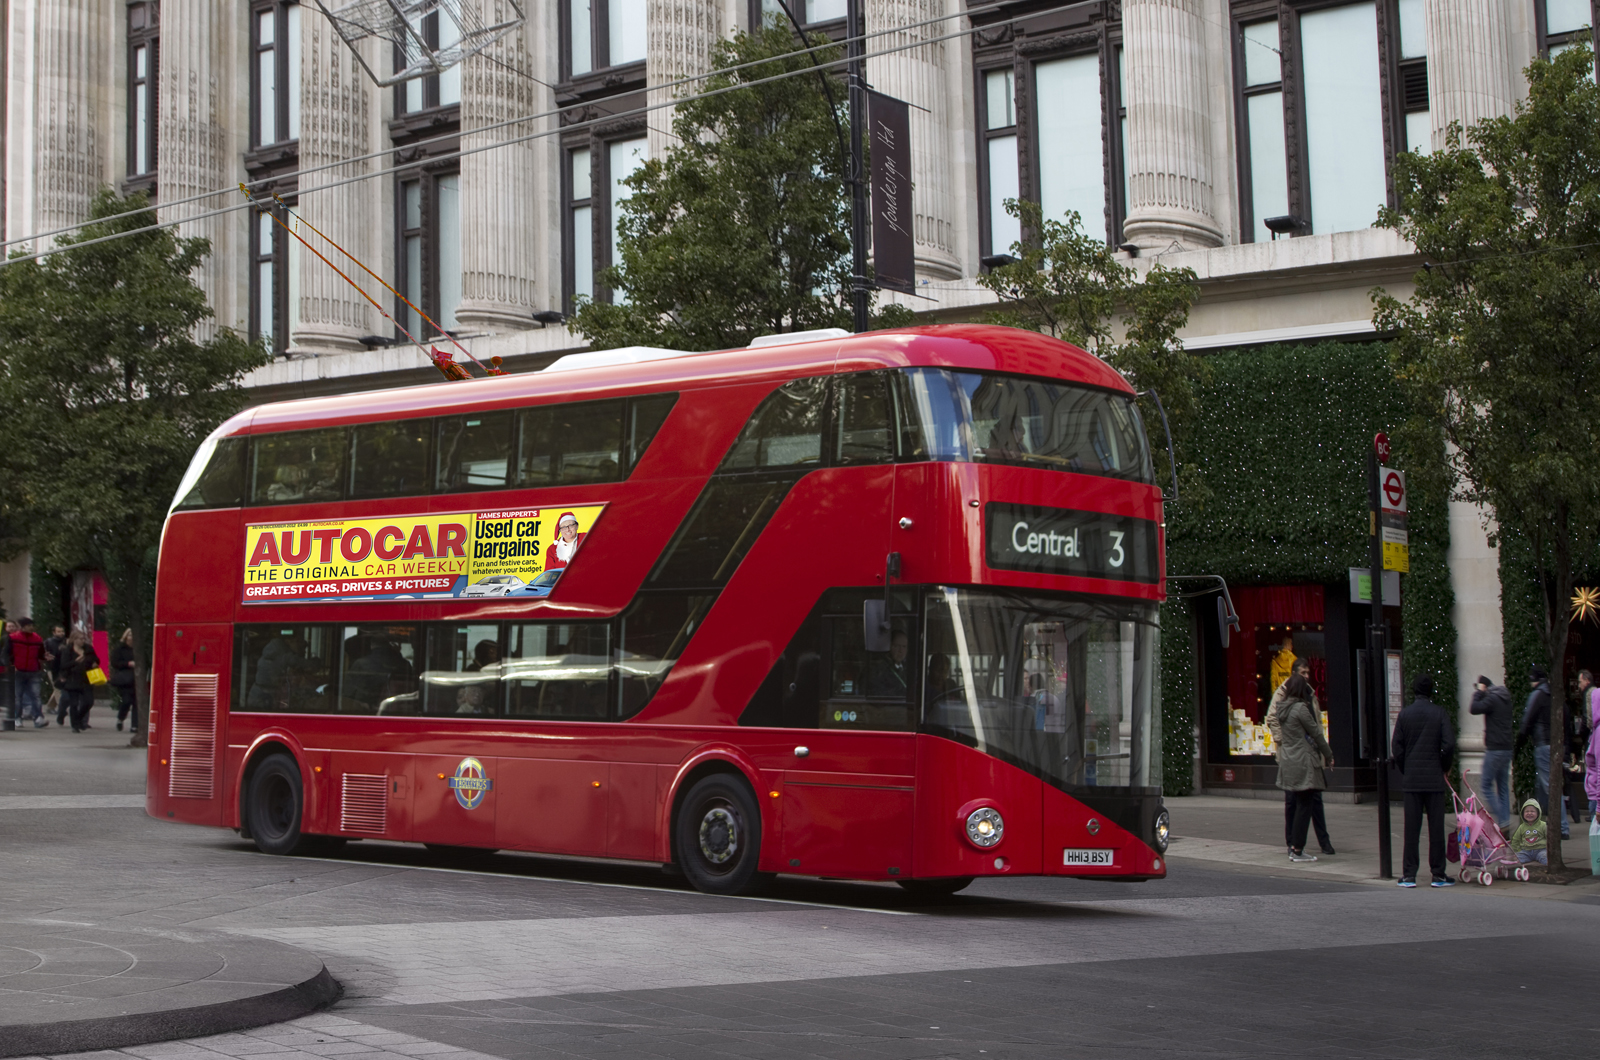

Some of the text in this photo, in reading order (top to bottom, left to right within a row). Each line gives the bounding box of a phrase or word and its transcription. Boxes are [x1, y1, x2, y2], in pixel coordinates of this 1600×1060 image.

[1377, 442, 1389, 455] BC
[501, 510, 538, 518] RUPPERT'S
[475, 519, 542, 539] Used car
[247, 523, 467, 567] AUTOCAR
[473, 538, 540, 559] bargains
[1012, 521, 1125, 568] Central 3
[247, 560, 466, 581] THE ORIGINAL CAR WEEKLY
[472, 567, 502, 575] whatever
[519, 565, 542, 573] budget
[246, 578, 450, 597] GREATEST CARS, DRIVES & PICTURES
[1067, 851, 1110, 863] HH13 BSY
